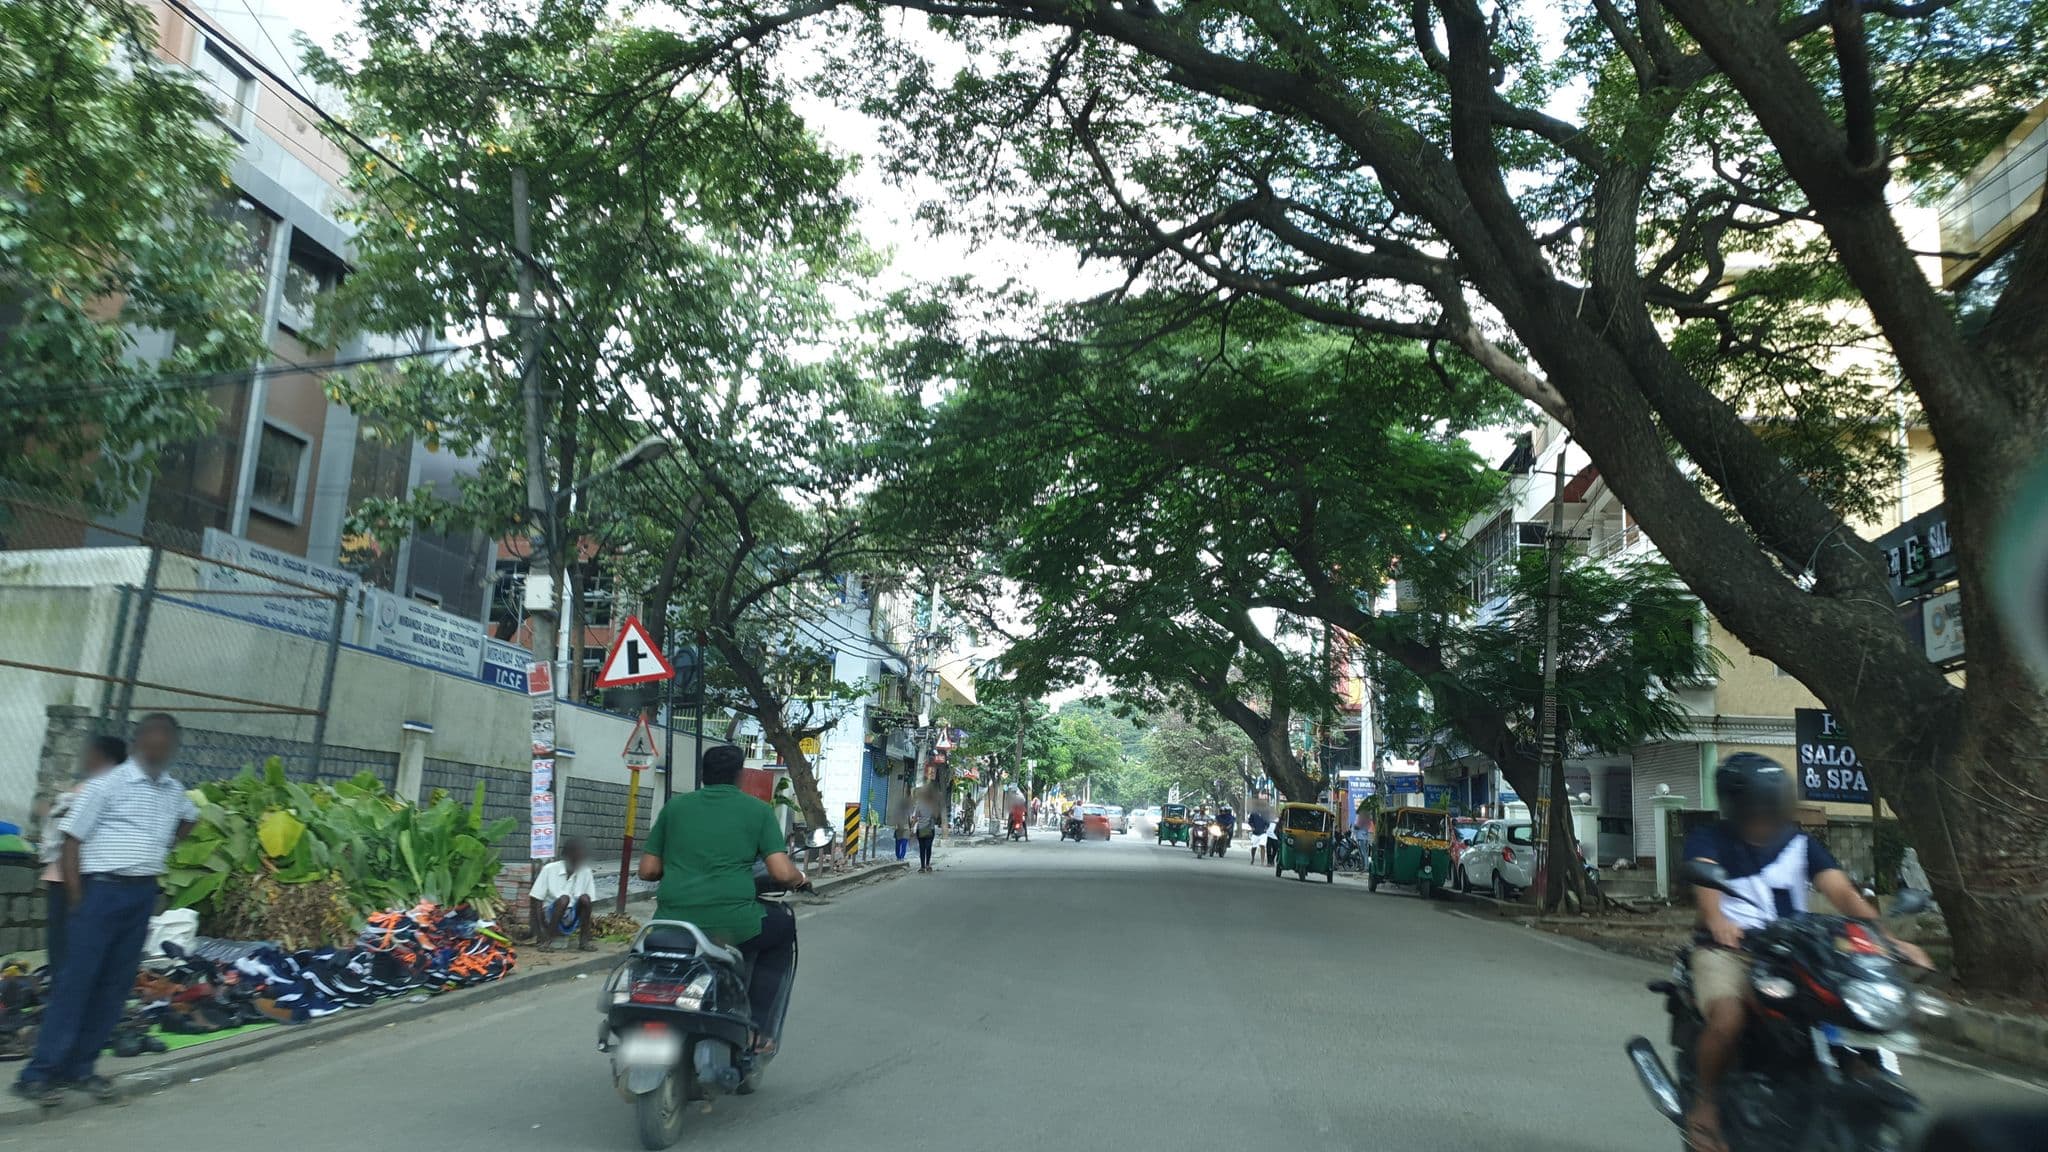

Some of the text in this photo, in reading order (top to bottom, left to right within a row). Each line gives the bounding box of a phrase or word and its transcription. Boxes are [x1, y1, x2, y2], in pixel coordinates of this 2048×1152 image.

[412, 632, 441, 649] MIRANDA
[441, 641, 465, 658] SCHOOL
[1801, 743, 1863, 768] SALO
[1805, 767, 1869, 792] & SPA
